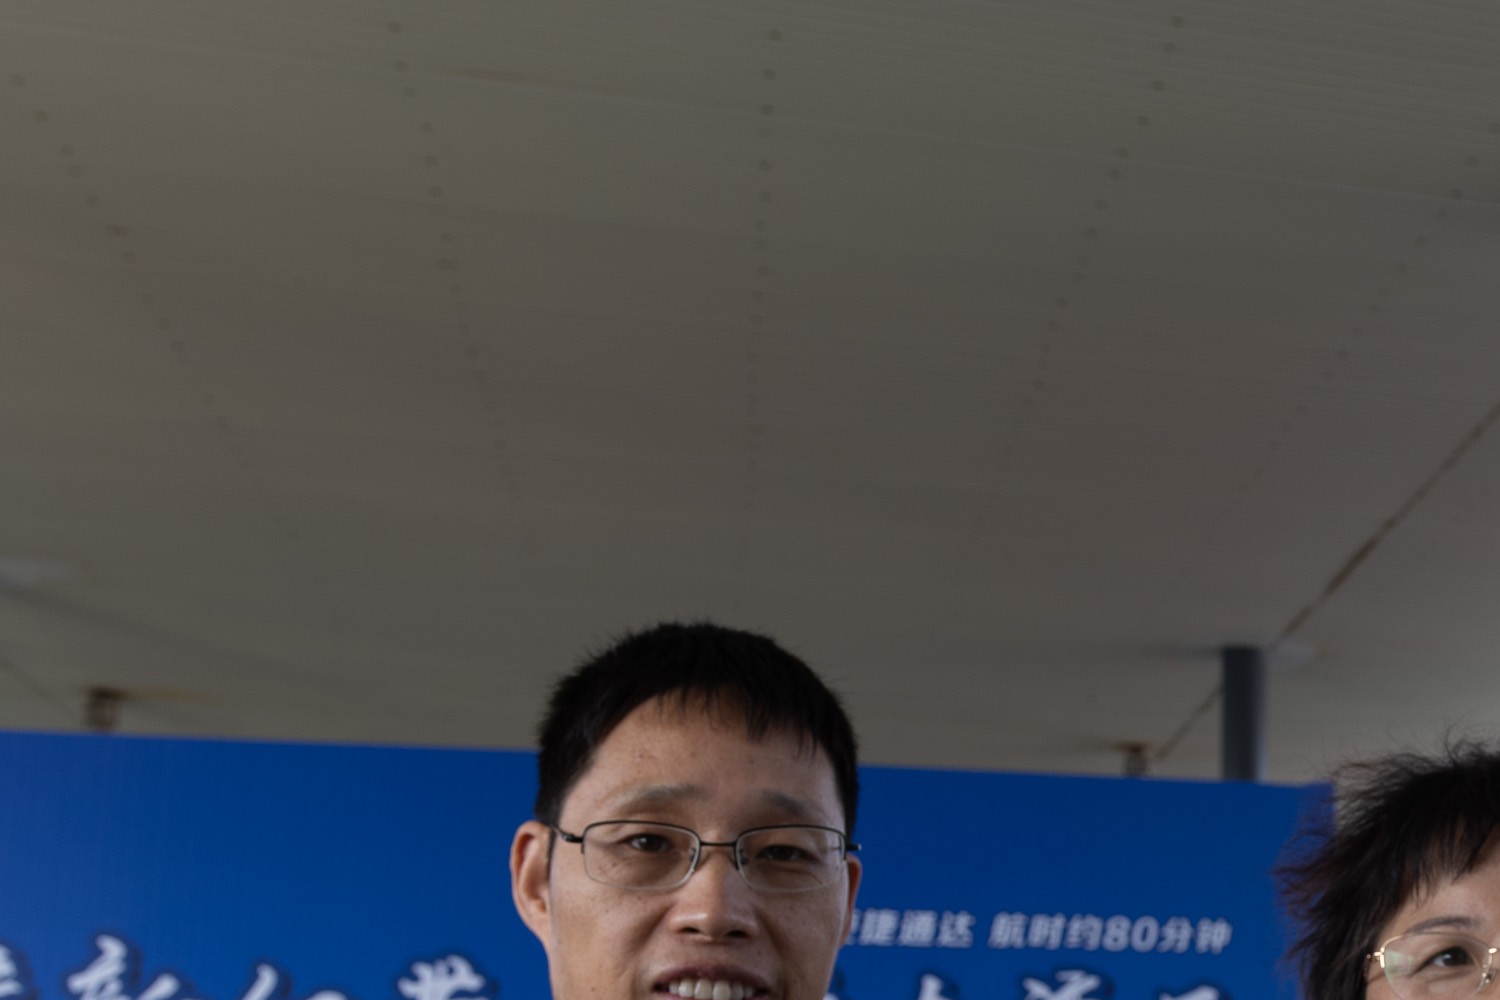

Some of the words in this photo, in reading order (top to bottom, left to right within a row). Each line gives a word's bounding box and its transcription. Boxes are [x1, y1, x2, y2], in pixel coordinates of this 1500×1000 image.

[988, 911, 1233, 955] 航时约80分钟
